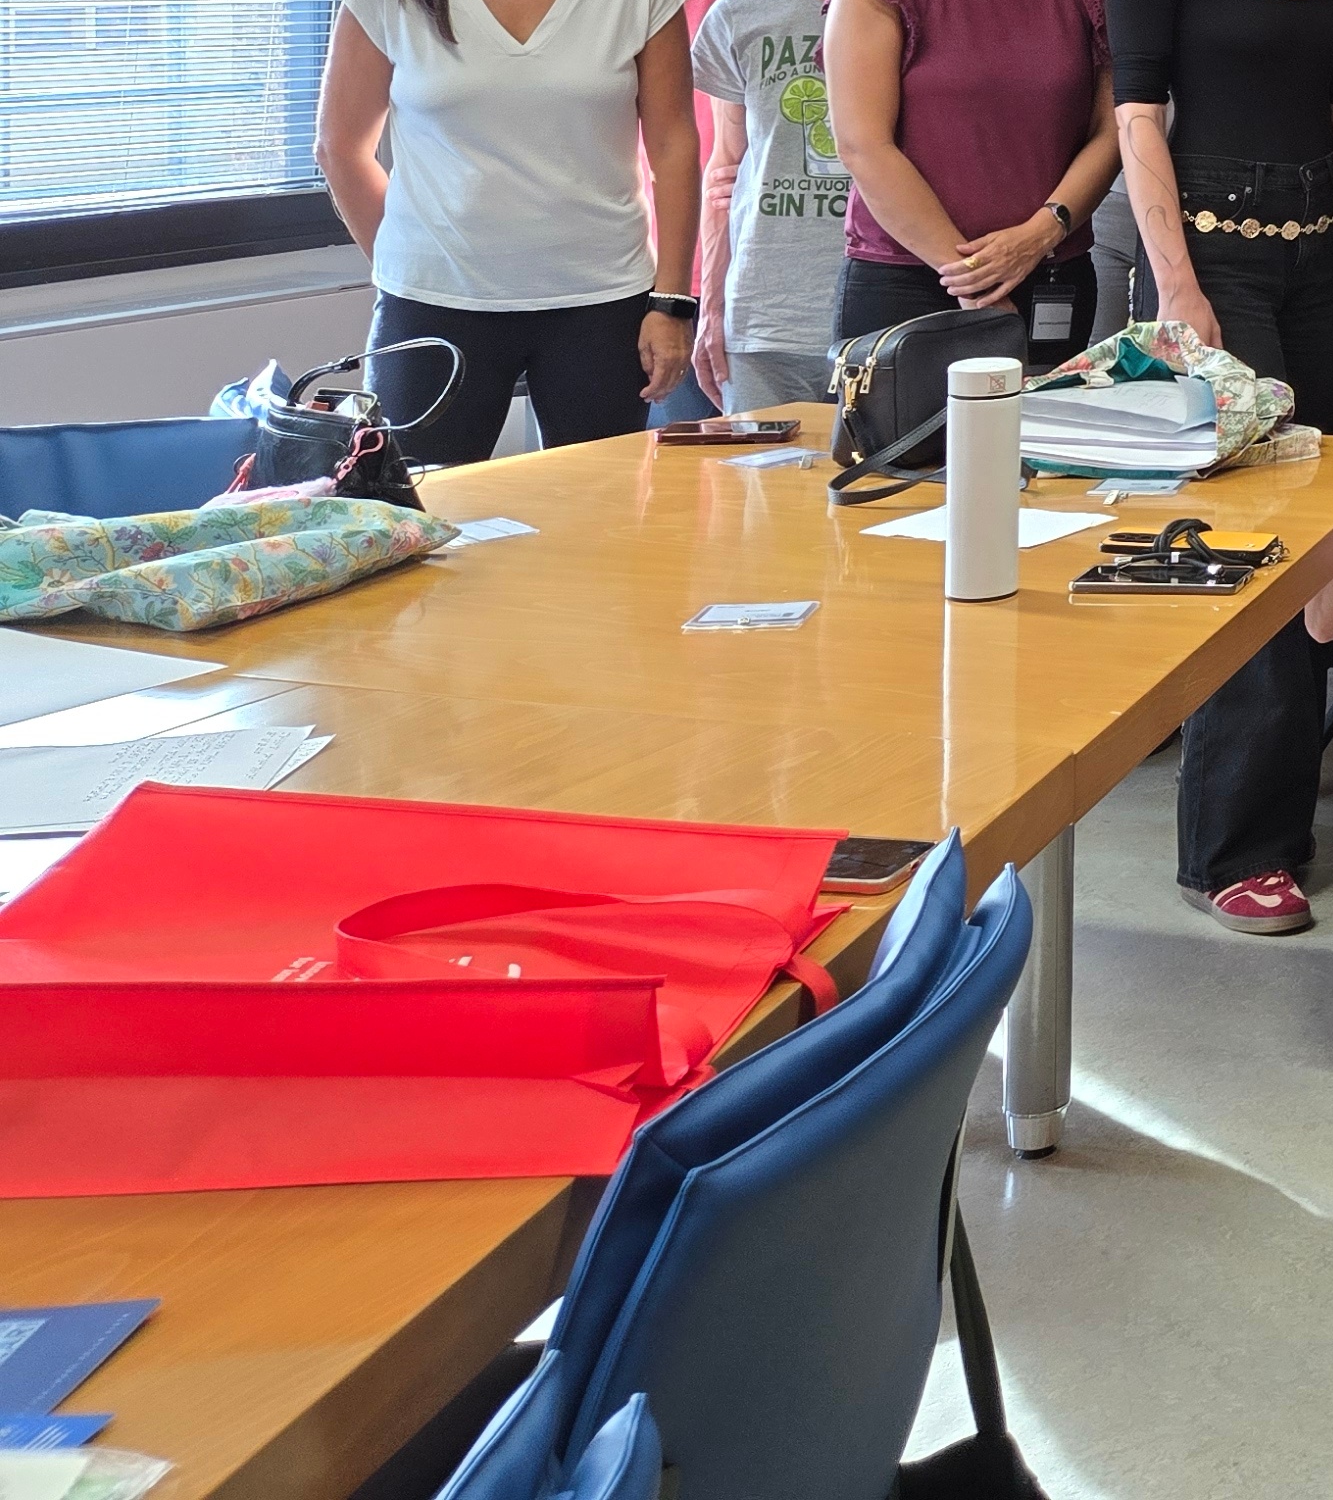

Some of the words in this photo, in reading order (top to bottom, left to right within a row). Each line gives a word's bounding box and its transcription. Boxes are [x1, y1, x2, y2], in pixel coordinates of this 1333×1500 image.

[760, 71, 787, 90] FINO
[790, 69, 799, 77] A
[773, 178, 795, 191] POI
[797, 178, 811, 191] CI
[758, 193, 805, 218] GIN
[813, 193, 849, 218] TO
